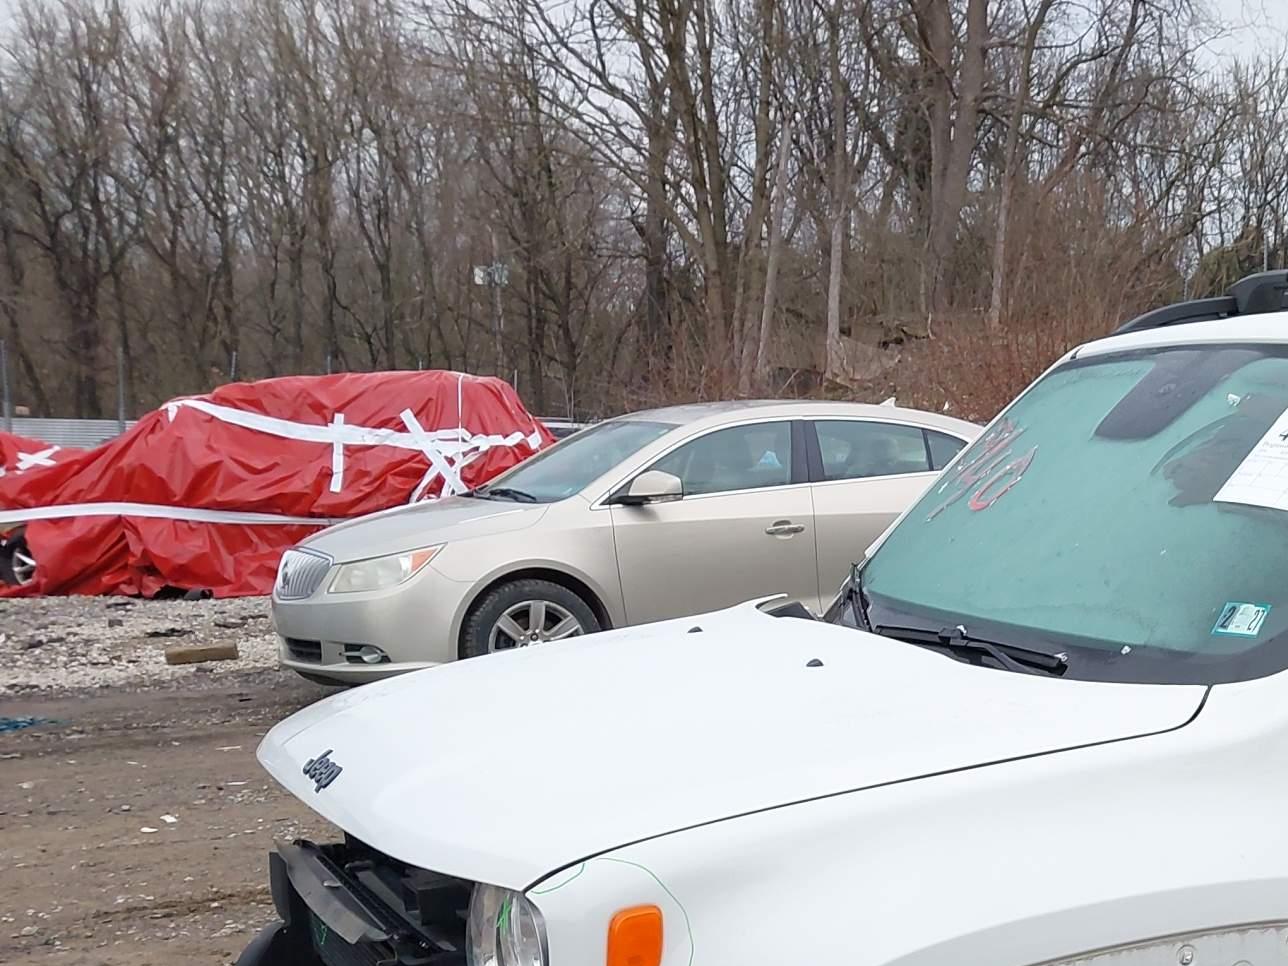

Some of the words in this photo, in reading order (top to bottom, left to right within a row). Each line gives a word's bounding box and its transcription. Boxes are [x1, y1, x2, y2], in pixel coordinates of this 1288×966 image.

[1219, 605, 1237, 628] 2
[1246, 608, 1266, 633] 27
[302, 749, 343, 794] Jeep
